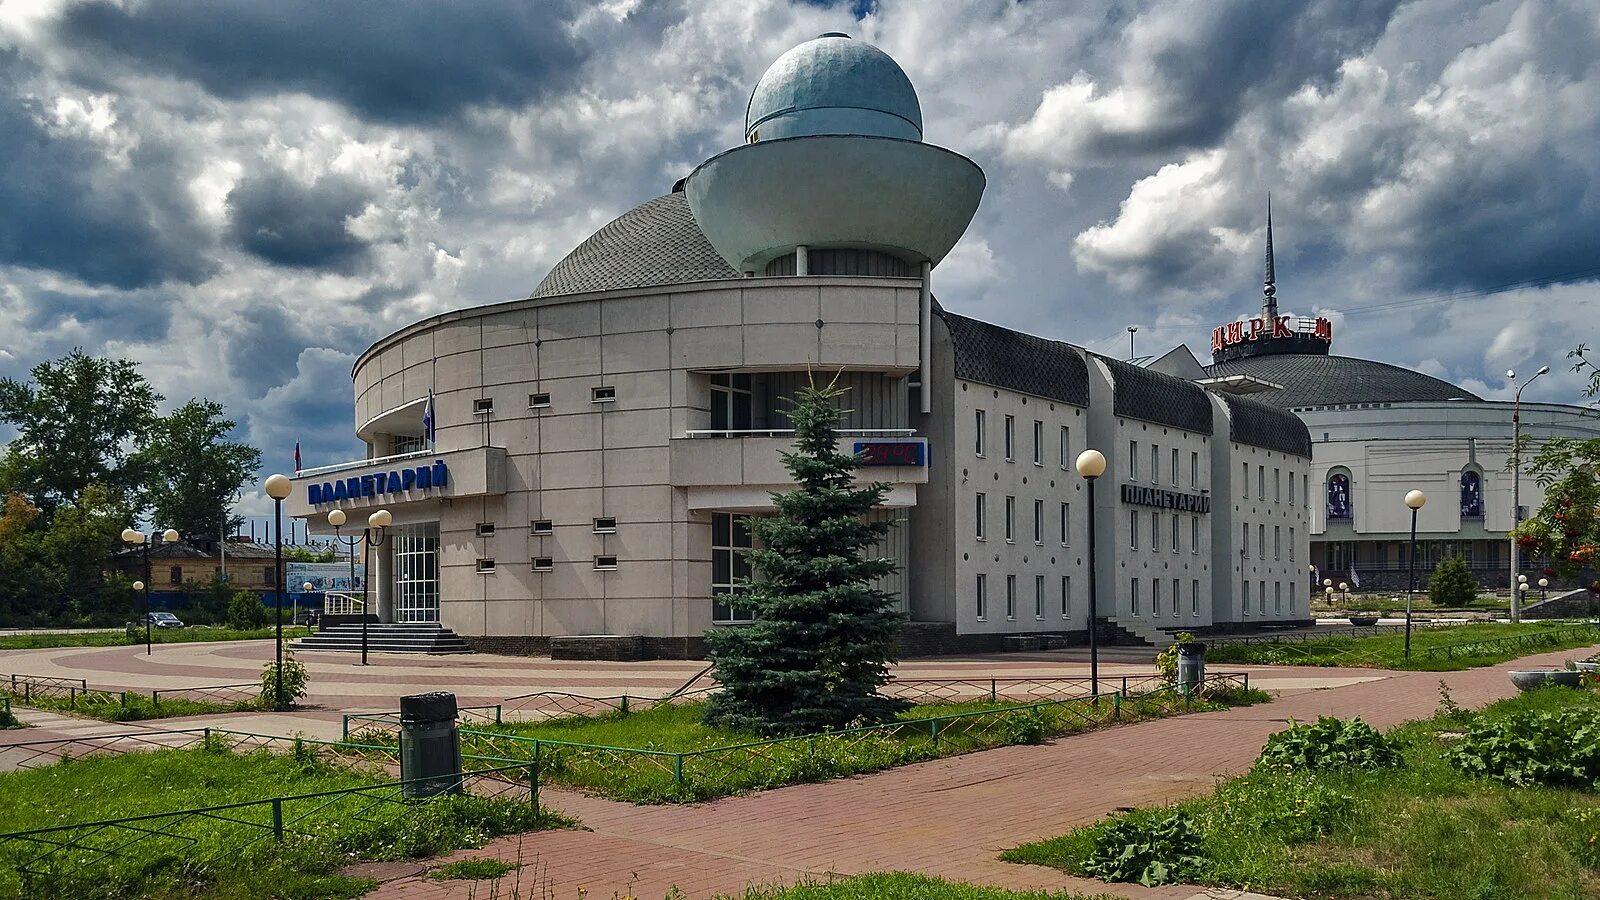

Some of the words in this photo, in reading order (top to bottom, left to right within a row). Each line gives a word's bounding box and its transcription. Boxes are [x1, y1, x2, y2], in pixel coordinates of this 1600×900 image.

[1211, 316, 1292, 351] ЦИРК
[308, 459, 448, 504] ПЛАНЕТАРИЙ
[1121, 484, 1211, 513] ПЛАНЕТАРИЙ
